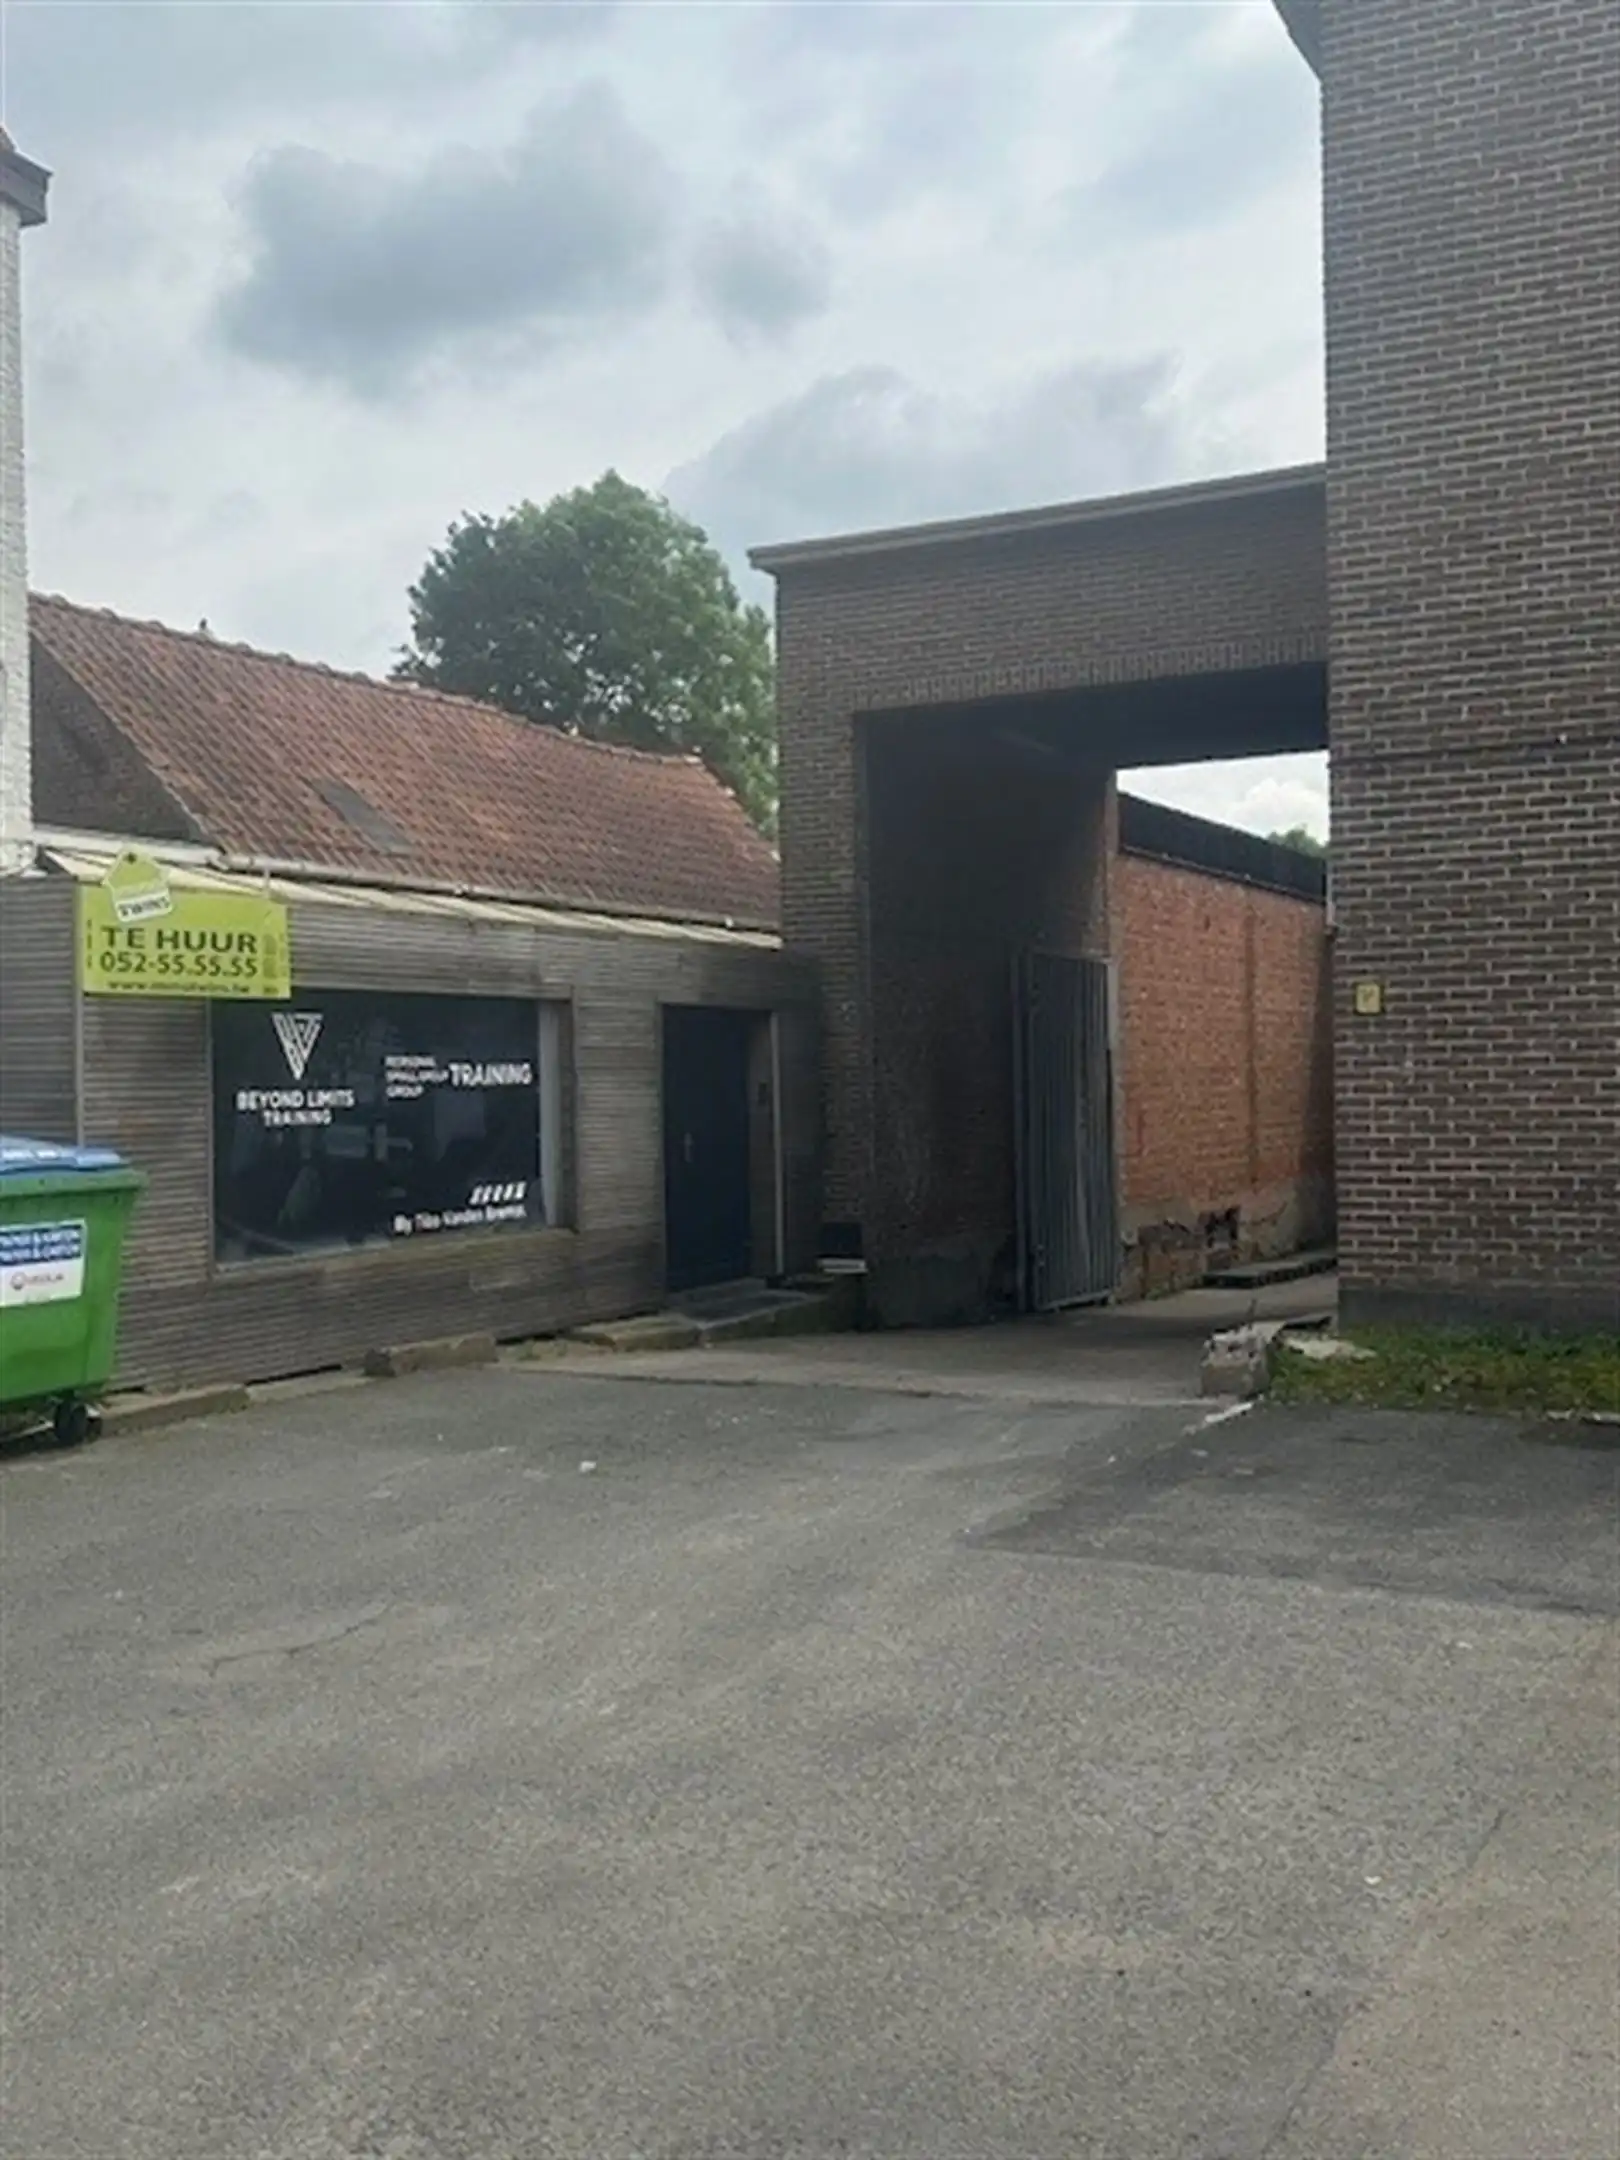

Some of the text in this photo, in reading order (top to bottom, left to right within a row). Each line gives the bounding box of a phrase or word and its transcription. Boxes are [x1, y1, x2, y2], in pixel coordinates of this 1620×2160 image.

[100, 926, 145, 950] TE
[157, 928, 258, 954] HUUR
[99, 951, 258, 978] 052-55.55.55
[448, 1062, 532, 1086] TRAINING
[236, 1089, 356, 1111] BEYOND LIMITS
[263, 1108, 333, 1127] TRAINING
